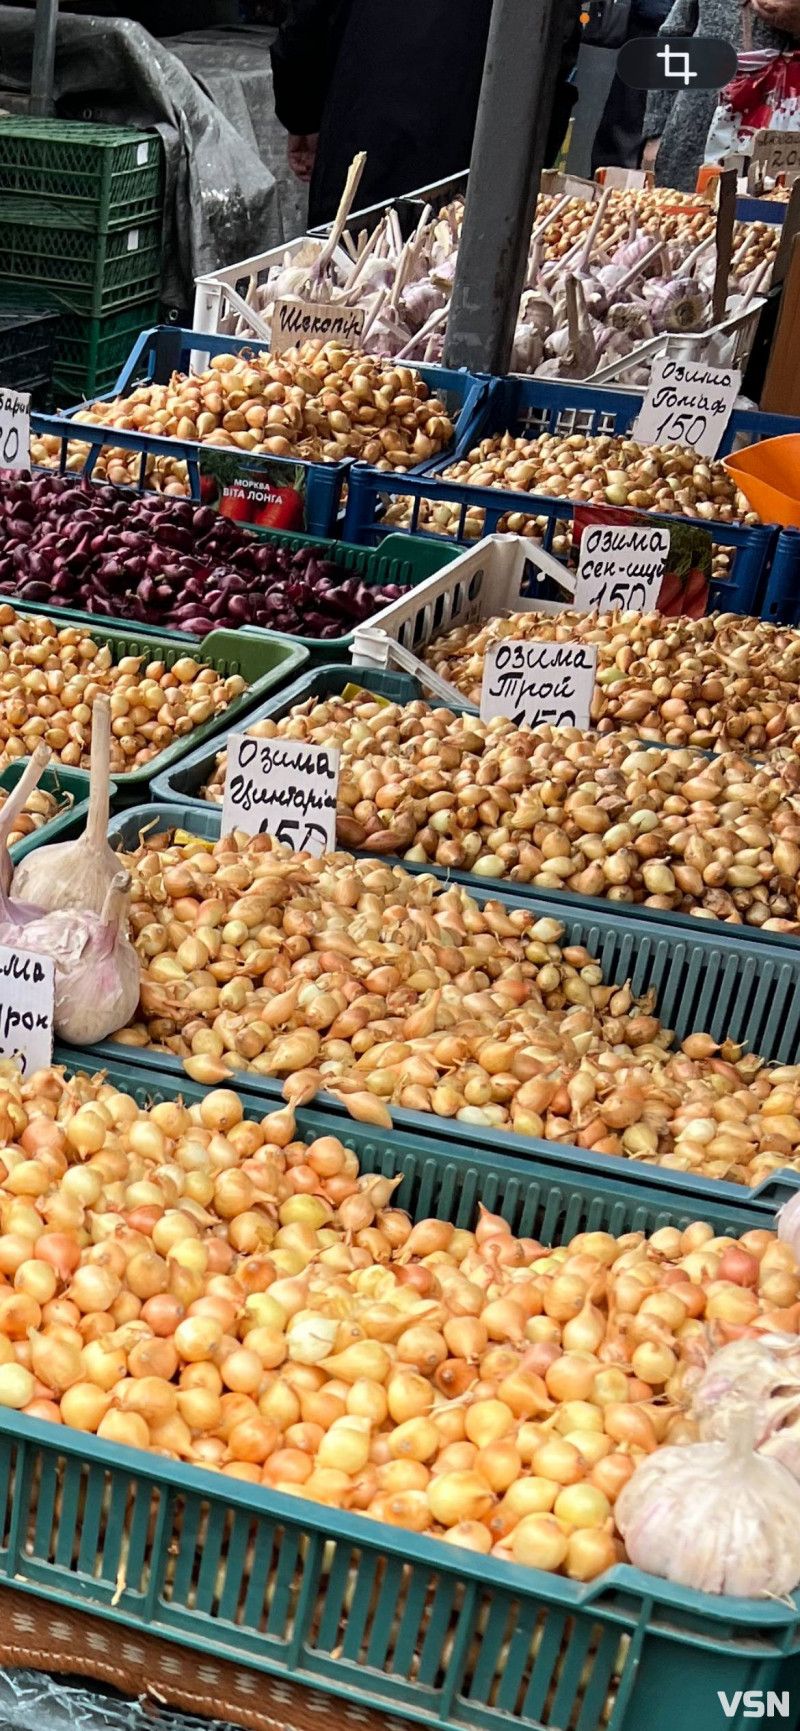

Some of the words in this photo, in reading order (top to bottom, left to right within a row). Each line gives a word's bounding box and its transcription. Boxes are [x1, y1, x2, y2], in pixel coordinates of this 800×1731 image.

[655, 413, 707, 445] 150
[223, 487, 246, 500] ВІТА
[247, 490, 283, 504] ЛОНГА
[234, 479, 270, 491] МОРКВА
[589, 582, 646, 614] 150
[489, 672, 575, 709] Трой
[238, 739, 335, 779] Озима
